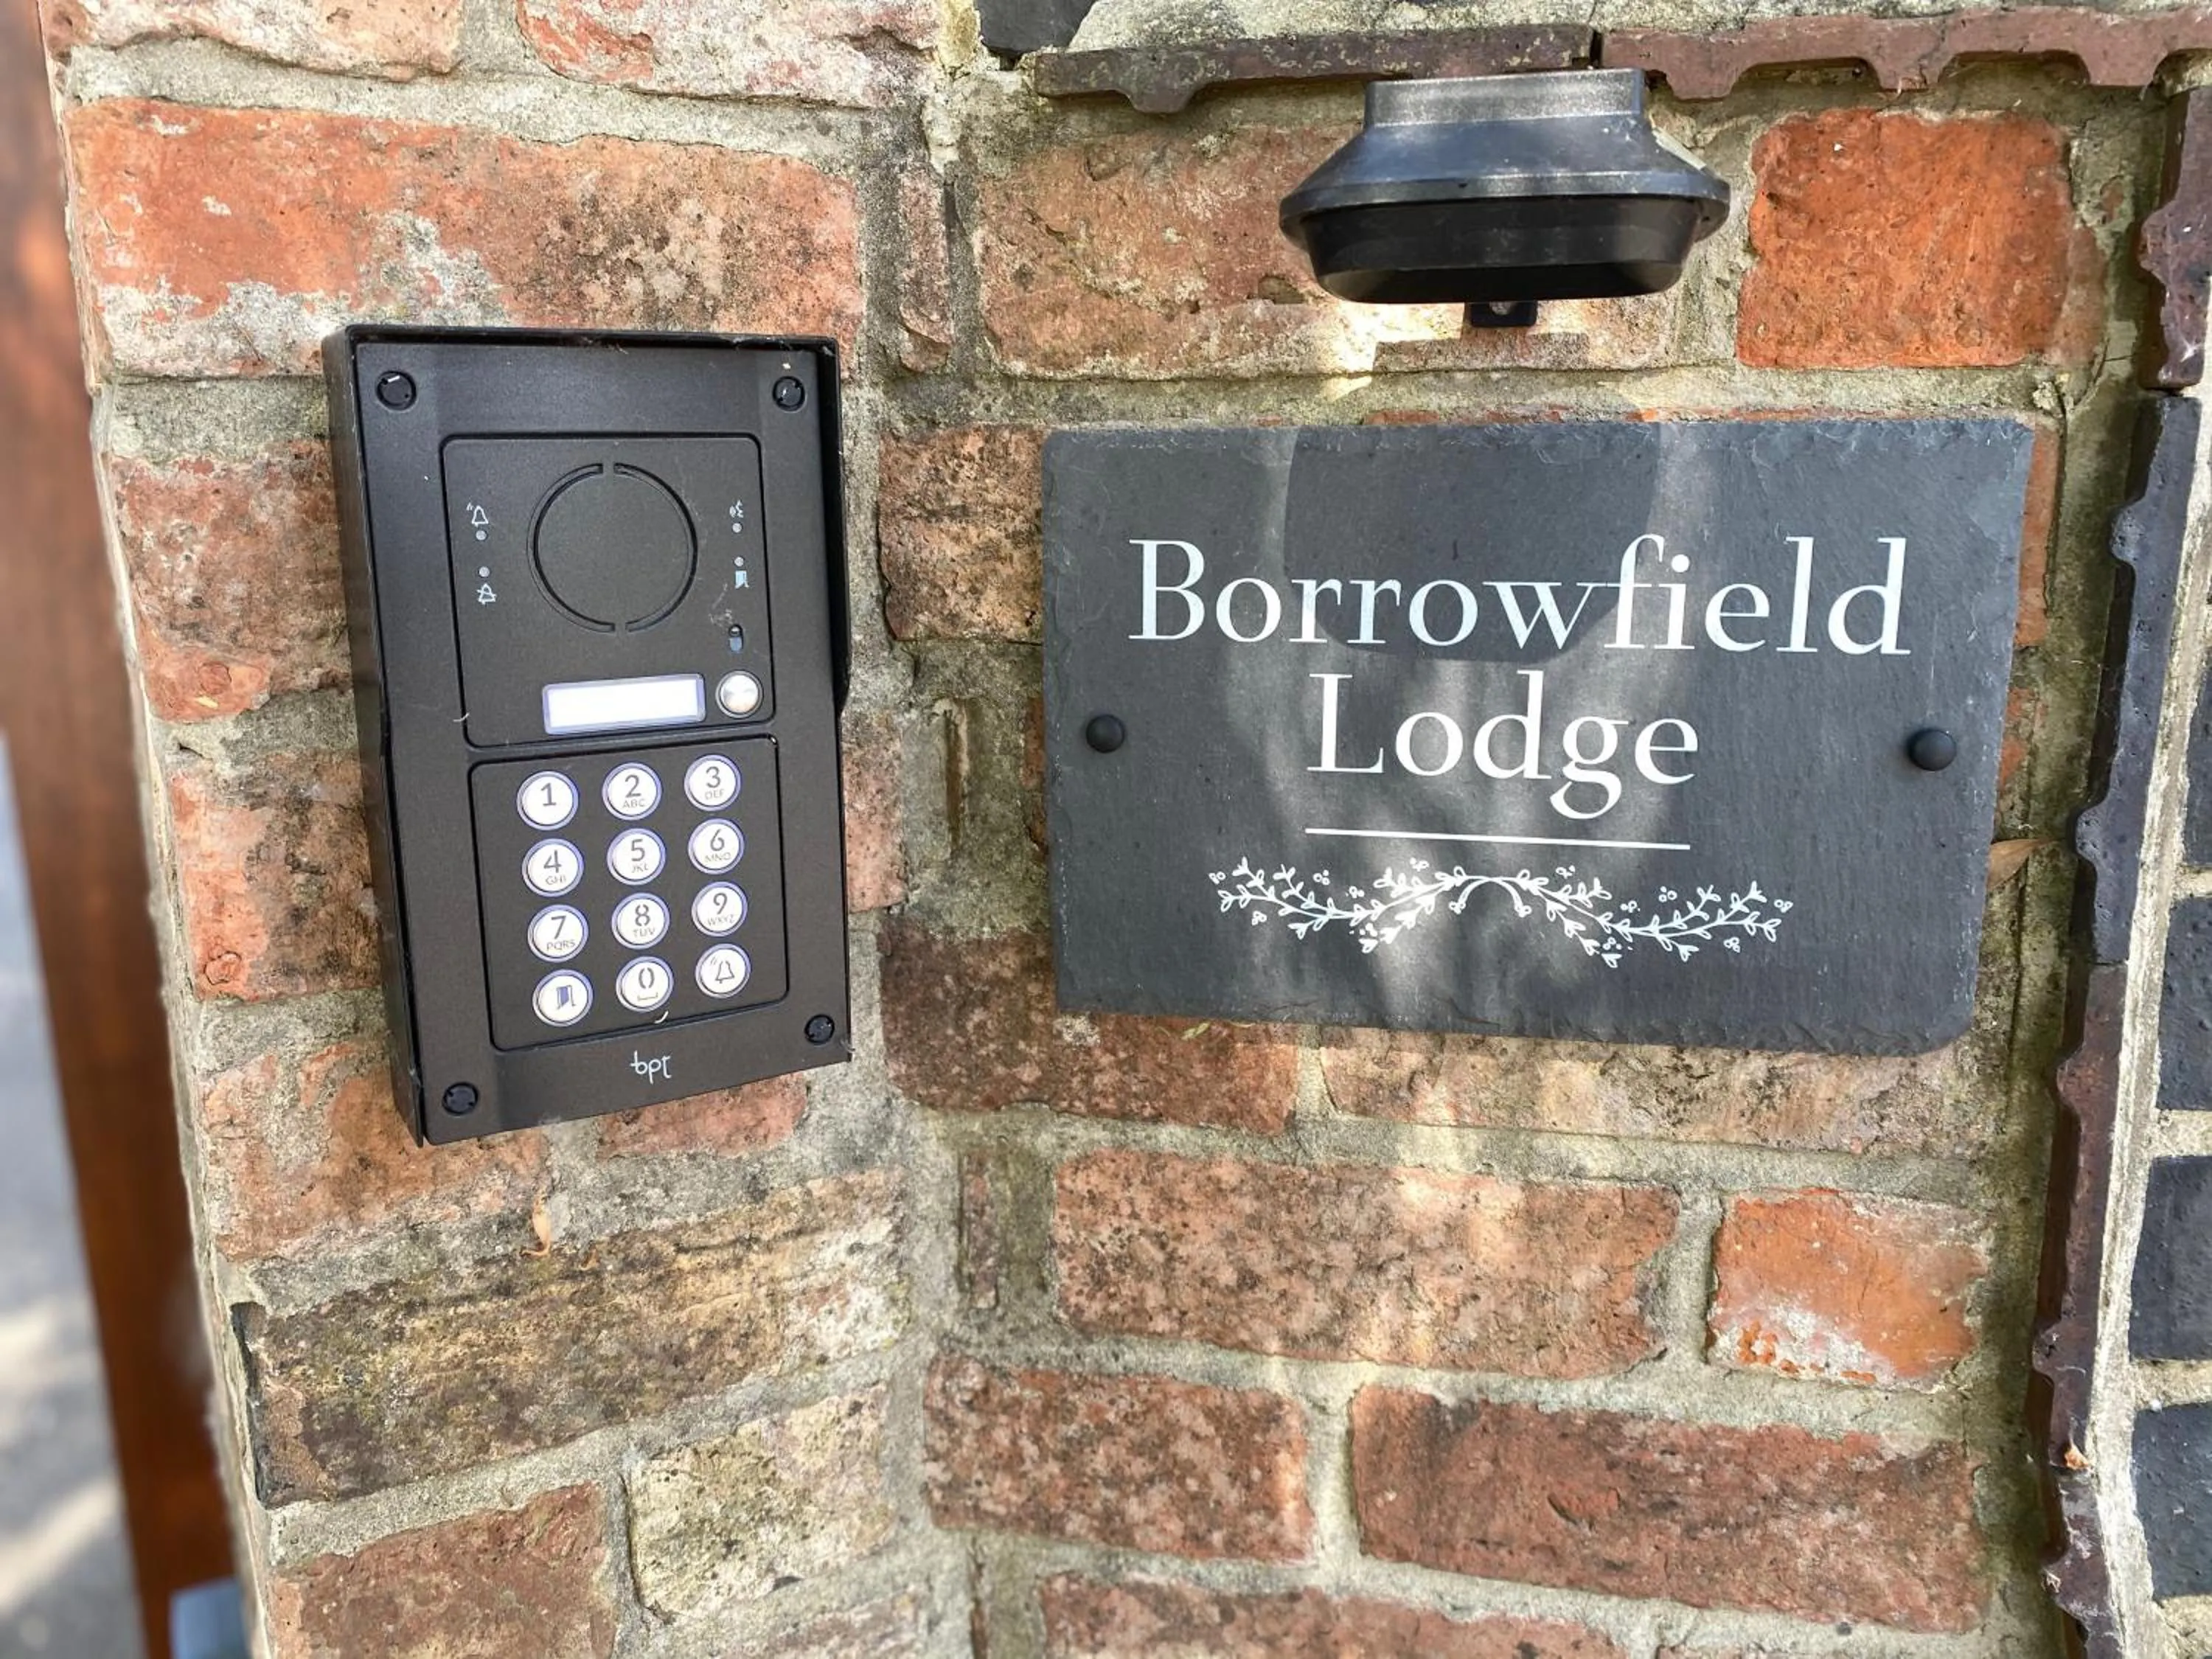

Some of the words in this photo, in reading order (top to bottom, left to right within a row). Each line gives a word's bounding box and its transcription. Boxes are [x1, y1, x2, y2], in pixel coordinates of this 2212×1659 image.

[1129, 532, 1911, 657] Borrowfield
[1306, 669, 1699, 820] Lodge
[625, 774, 641, 798] 2
[706, 766, 721, 788] 3
[540, 782, 557, 807] 1
[622, 798, 646, 809] ABC
[704, 789, 725, 800] DEF
[630, 838, 645, 862] 5
[710, 829, 725, 852] 6
[543, 849, 562, 873] 4
[631, 863, 649, 874] JKL
[704, 852, 731, 863] MNO
[545, 875, 567, 886] GHI
[713, 892, 728, 915] 9
[635, 904, 650, 927] 8
[551, 915, 567, 940] 7
[633, 928, 655, 939] TUV
[546, 939, 576, 952] PQRS
[638, 967, 655, 990] 0
